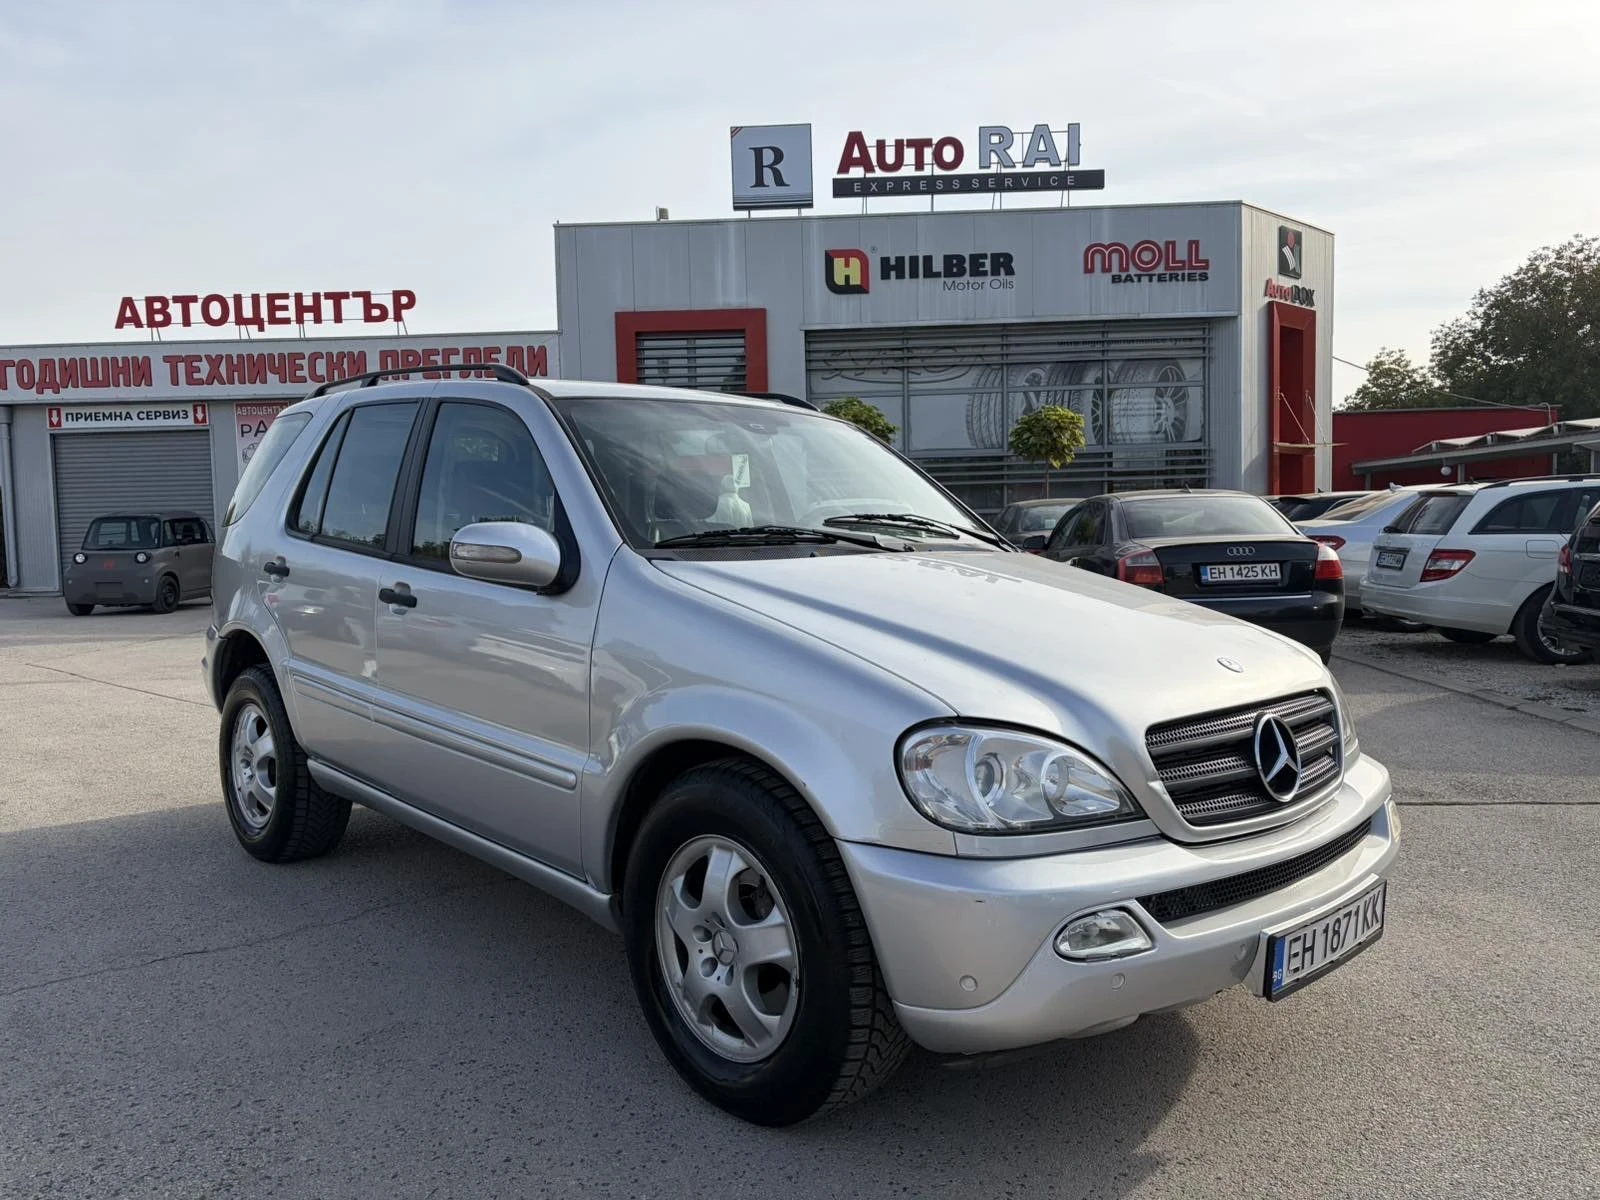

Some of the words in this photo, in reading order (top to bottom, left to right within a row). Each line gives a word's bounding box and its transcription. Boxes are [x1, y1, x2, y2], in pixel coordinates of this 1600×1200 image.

[979, 123, 1081, 169] RAI
[748, 146, 791, 188] R
[880, 252, 1016, 280] HILBER
[1111, 272, 1209, 284] BATTERIES
[943, 280, 986, 291] Motor
[989, 278, 1015, 290] Oils
[115, 290, 417, 332] АВТОЦЕНТЪР
[0, 355, 153, 395] ГОДИШНИ
[163, 350, 368, 386] ТЕХНИЧЕСКИ
[379, 345, 549, 380] ПРЕГЛЕДИ
[65, 411, 133, 422] ПРИЕМНА
[137, 409, 189, 421] СЕРВИЗ
[1209, 567, 1227, 579] EH
[1230, 565, 1259, 578] 1425
[1261, 564, 1278, 577] KH
[1288, 929, 1316, 974] EH
